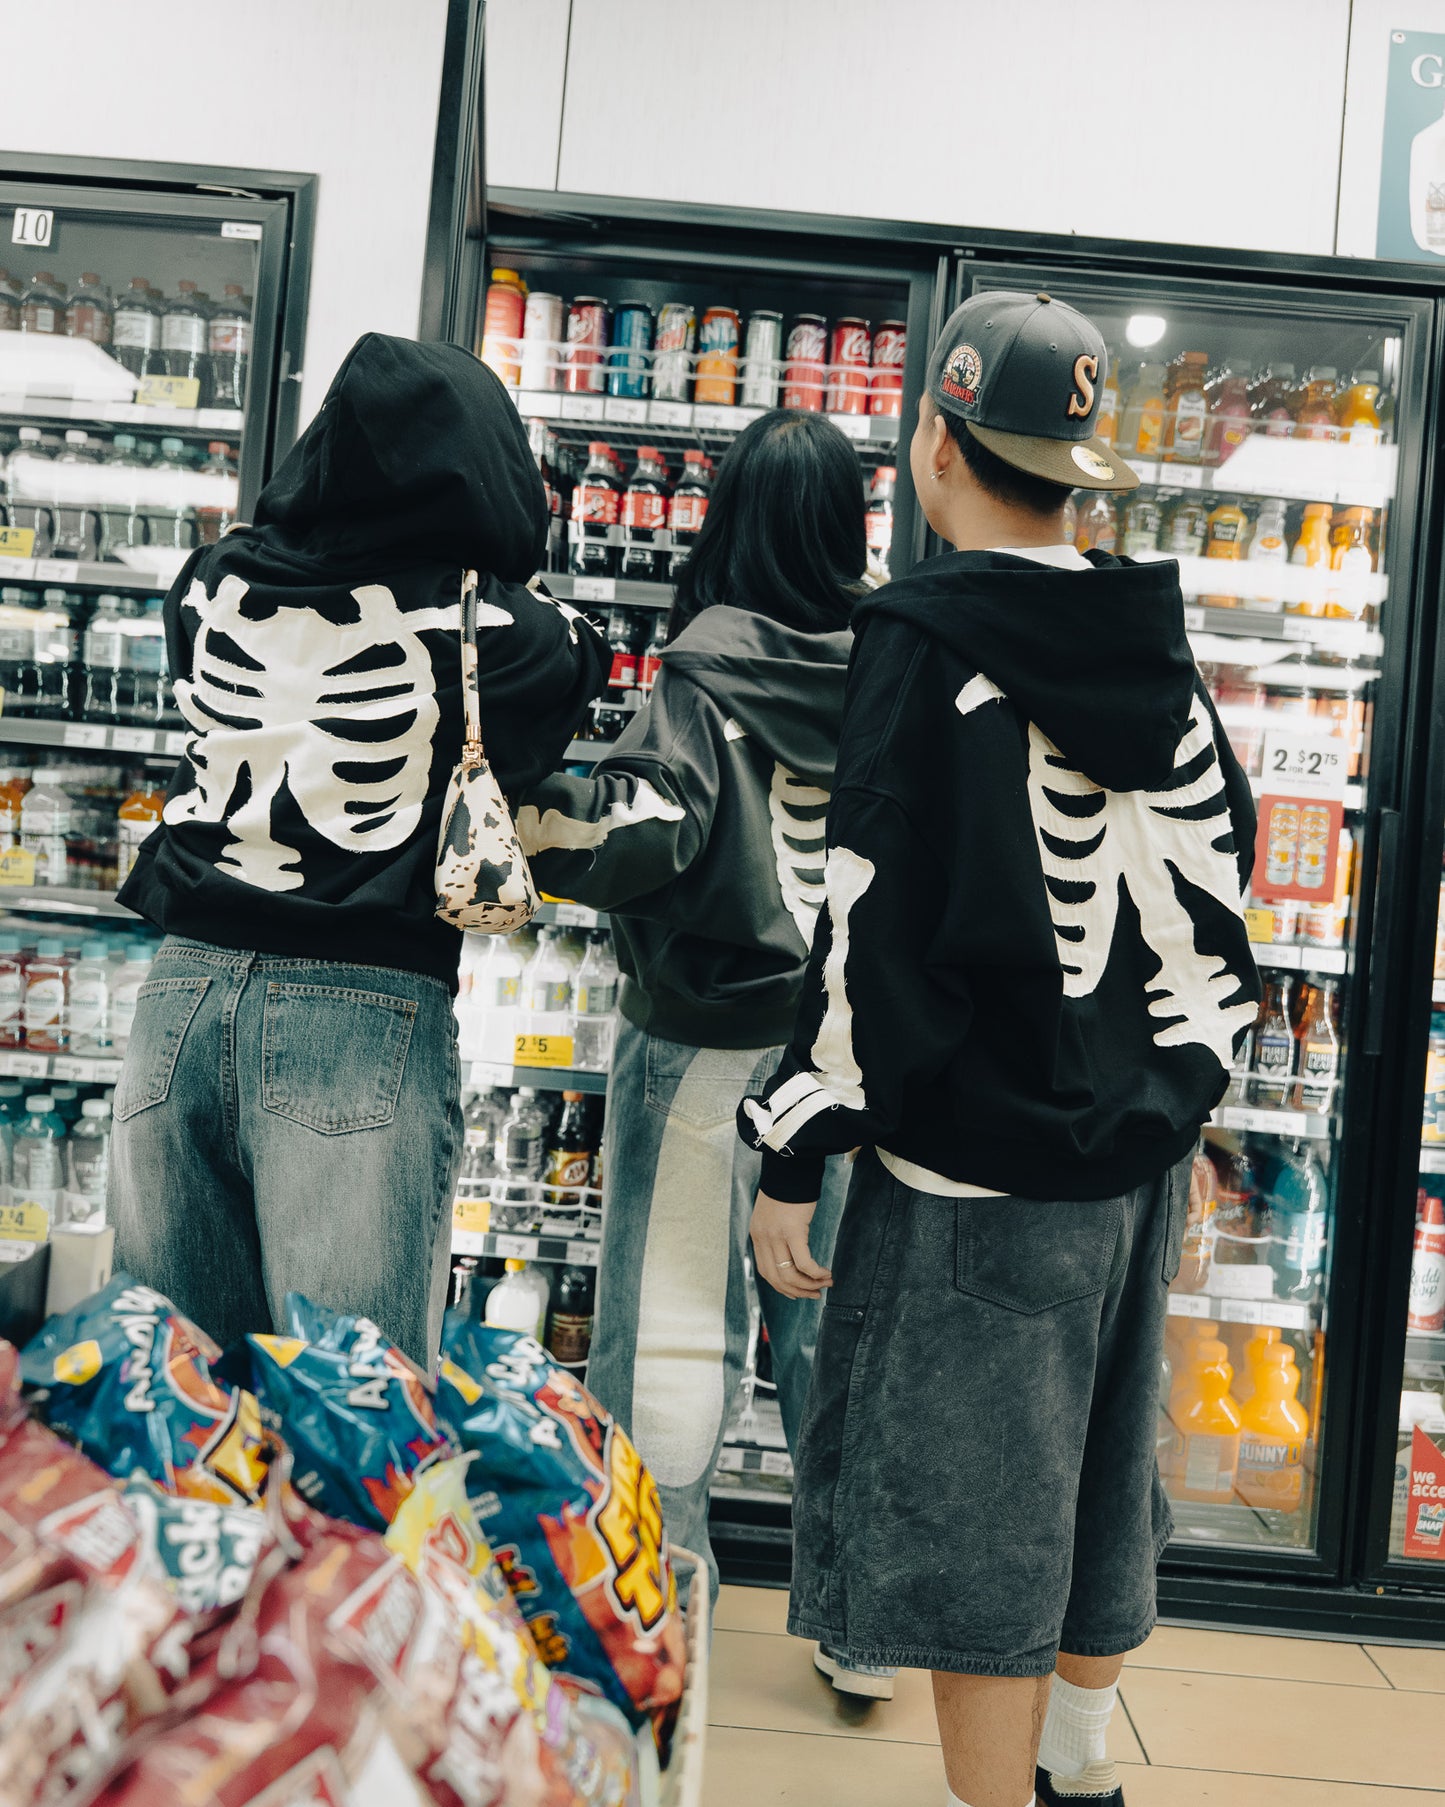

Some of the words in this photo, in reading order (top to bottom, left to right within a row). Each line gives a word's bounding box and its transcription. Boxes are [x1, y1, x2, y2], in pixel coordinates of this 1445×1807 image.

[1411, 53, 1445, 89] G
[17, 212, 48, 242] 10
[942, 376, 975, 403] MARINERS
[1067, 353, 1099, 419] S
[1273, 749, 1288, 771] 2
[517, 1037, 526, 1052] 2
[1413, 1470, 1436, 1484] we
